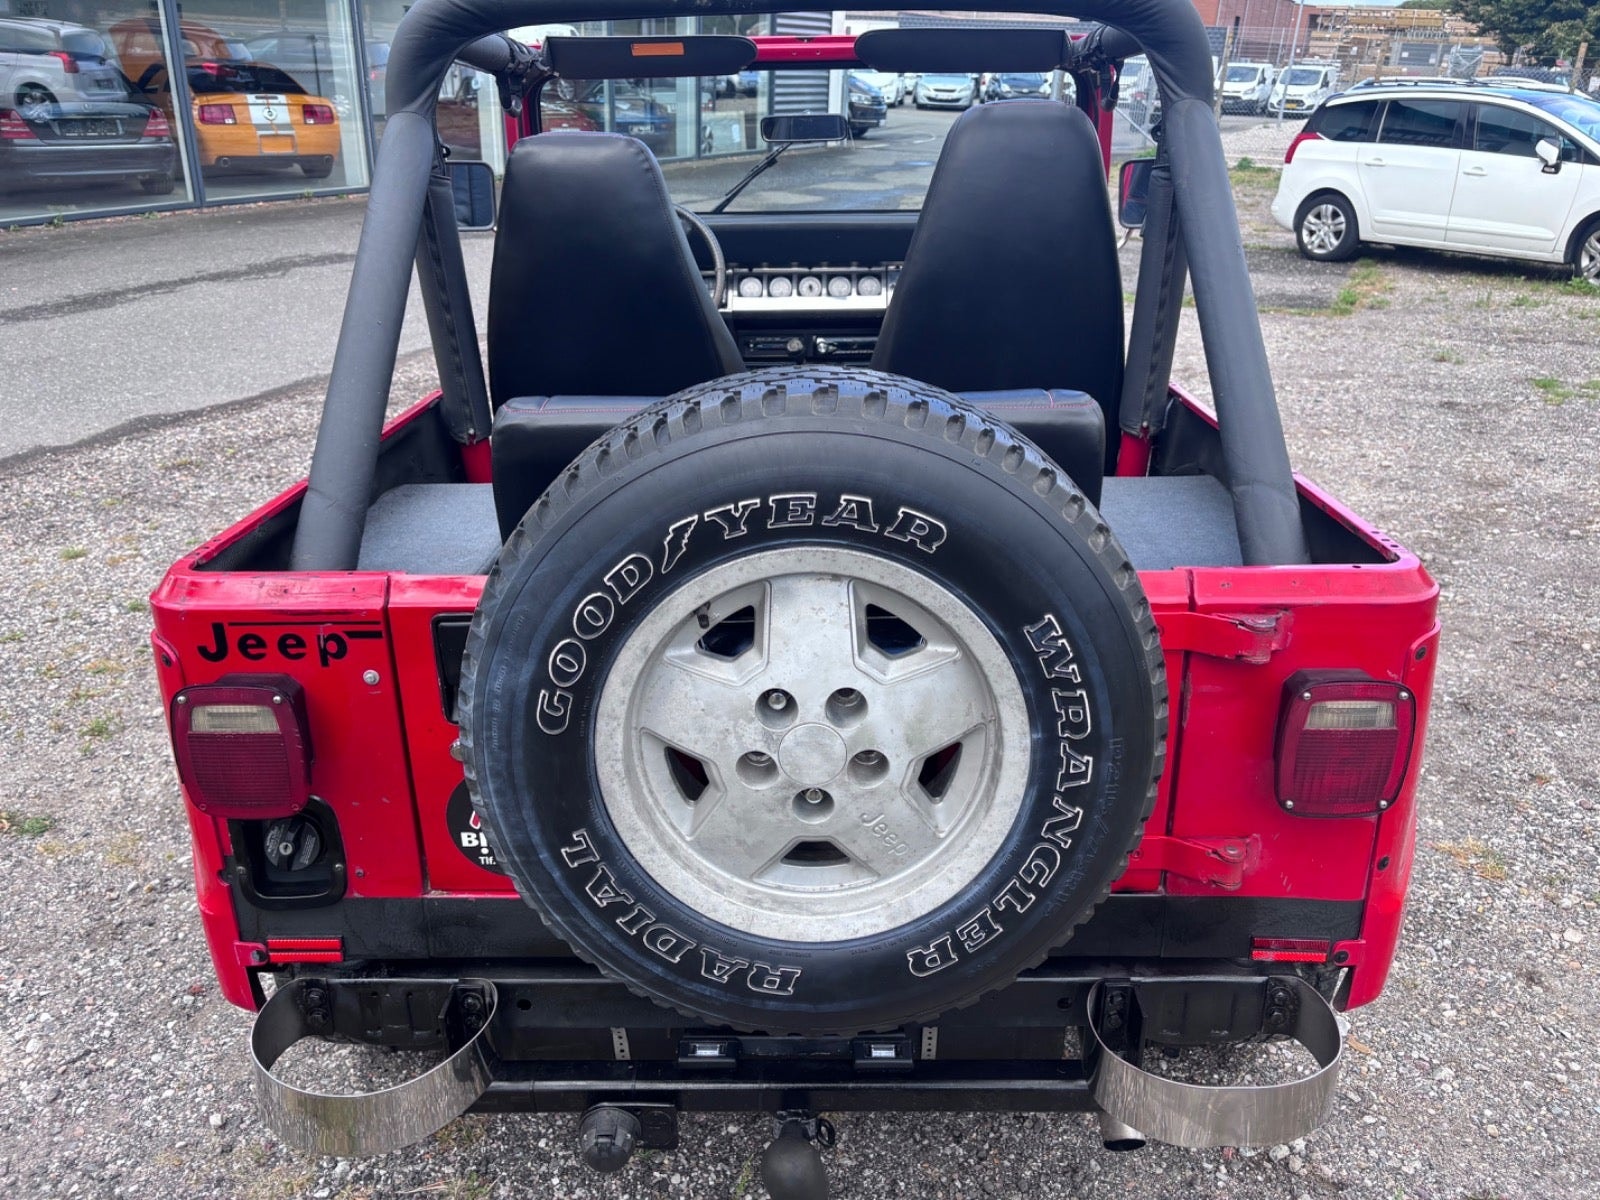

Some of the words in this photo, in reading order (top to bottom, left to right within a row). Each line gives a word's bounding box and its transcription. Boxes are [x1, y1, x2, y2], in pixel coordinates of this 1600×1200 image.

[197, 621, 348, 667] Jeep
[859, 811, 909, 856] Jeep
[907, 613, 1094, 978] WRANGLER
[561, 828, 803, 996] RADIAL
